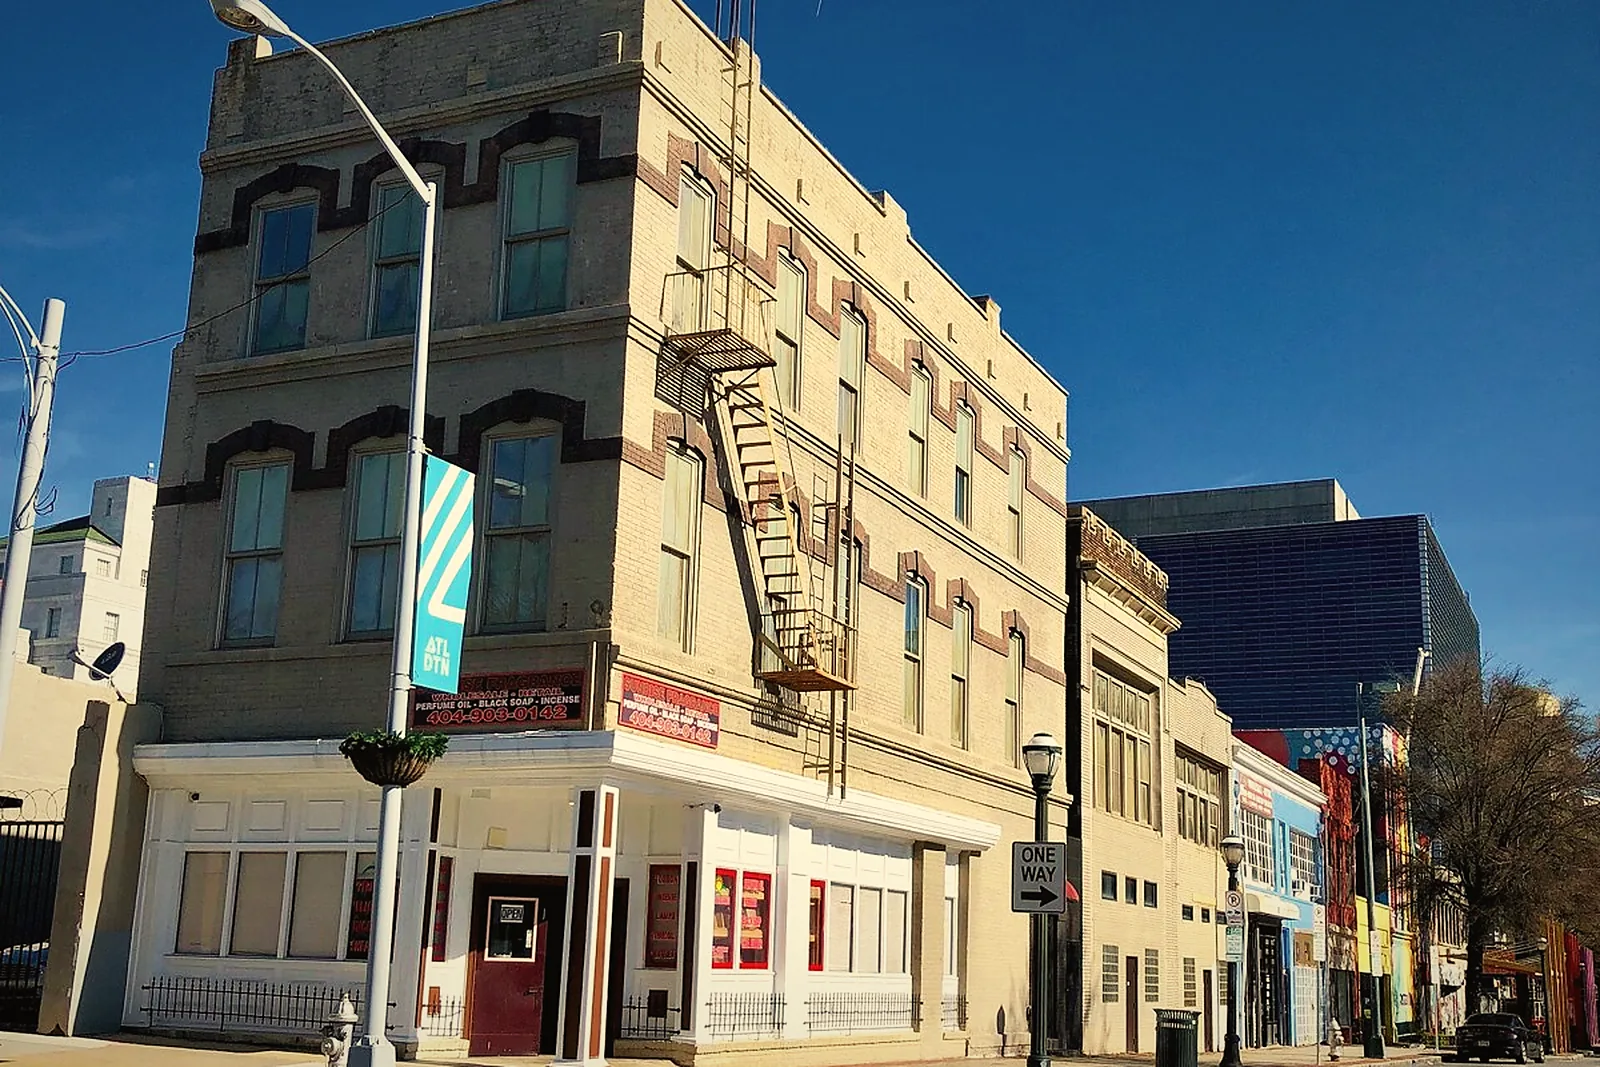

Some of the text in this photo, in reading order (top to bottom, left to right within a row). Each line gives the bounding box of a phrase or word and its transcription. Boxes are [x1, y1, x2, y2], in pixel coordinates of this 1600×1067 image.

[424, 635, 450, 658] ATL
[423, 652, 450, 677] DTN
[518, 687, 564, 697] RETAIL
[416, 695, 580, 710] PERFUME OIL BLACK SOAP INCENSE
[426, 704, 567, 724] 404-903-0142
[629, 710, 712, 743] 404-903-0142
[1021, 846, 1056, 863] ONE
[1021, 865, 1057, 882] WAY
